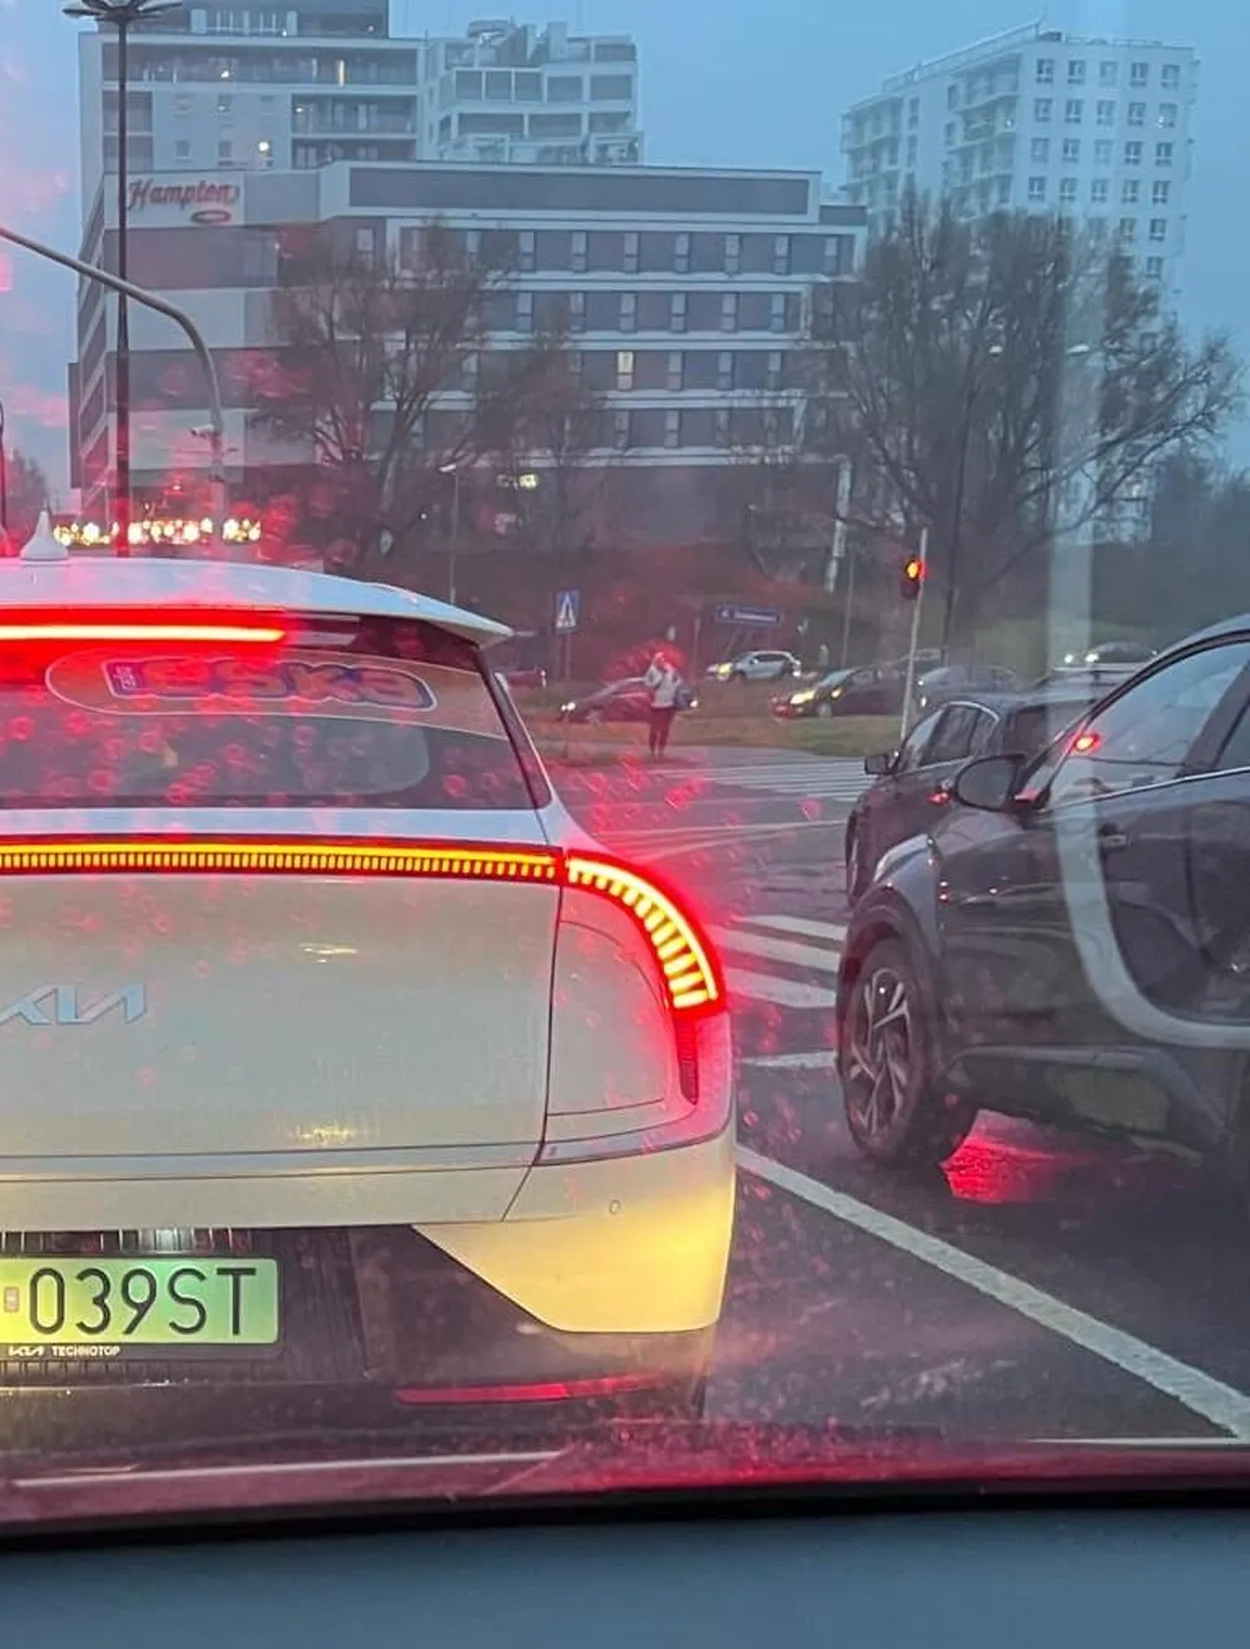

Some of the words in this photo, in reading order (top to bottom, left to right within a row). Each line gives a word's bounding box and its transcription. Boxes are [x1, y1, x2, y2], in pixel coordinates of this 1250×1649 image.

[128, 179, 239, 211] Hampton
[29, 1266, 257, 1336] 039ST
[52, 1345, 120, 1357] TECHNOTOP
